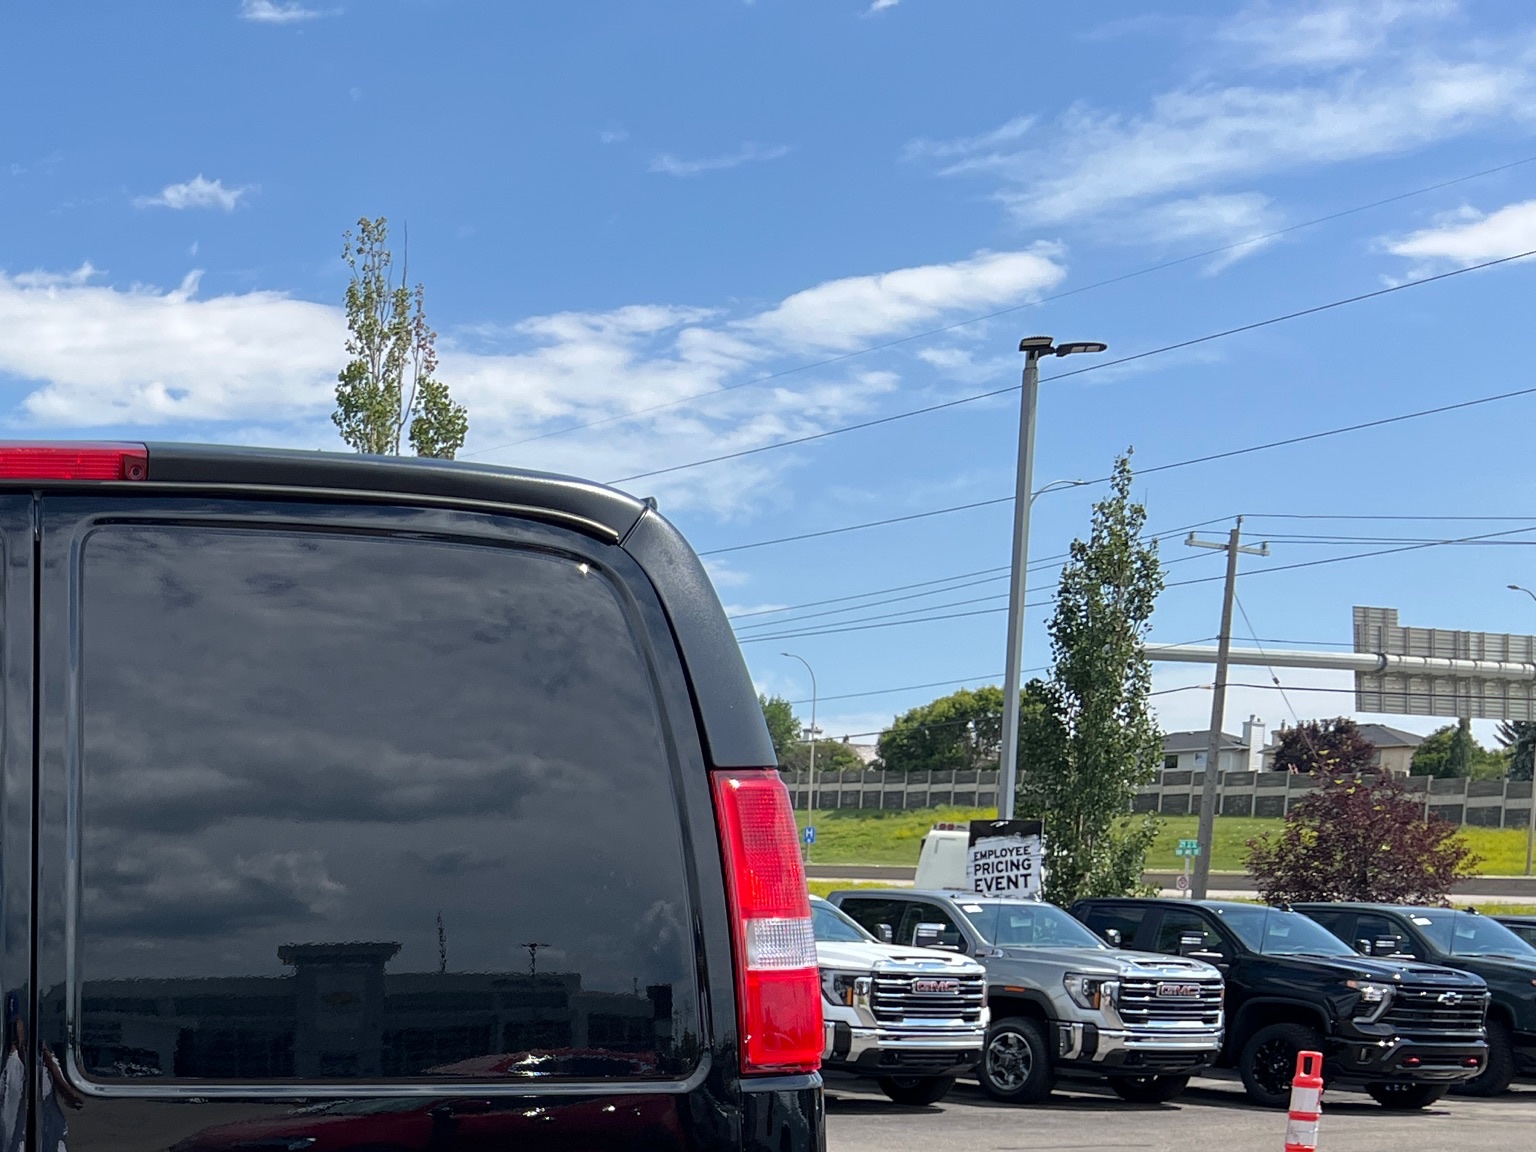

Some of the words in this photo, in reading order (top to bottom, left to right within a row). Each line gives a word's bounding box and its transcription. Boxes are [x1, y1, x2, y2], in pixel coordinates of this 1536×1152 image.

[974, 846, 1031, 862] EMPLOYEE
[974, 858, 1031, 876] PRICING
[975, 873, 1031, 893] EVENT
[916, 980, 960, 992] GMC
[1161, 985, 1200, 996] GMC
